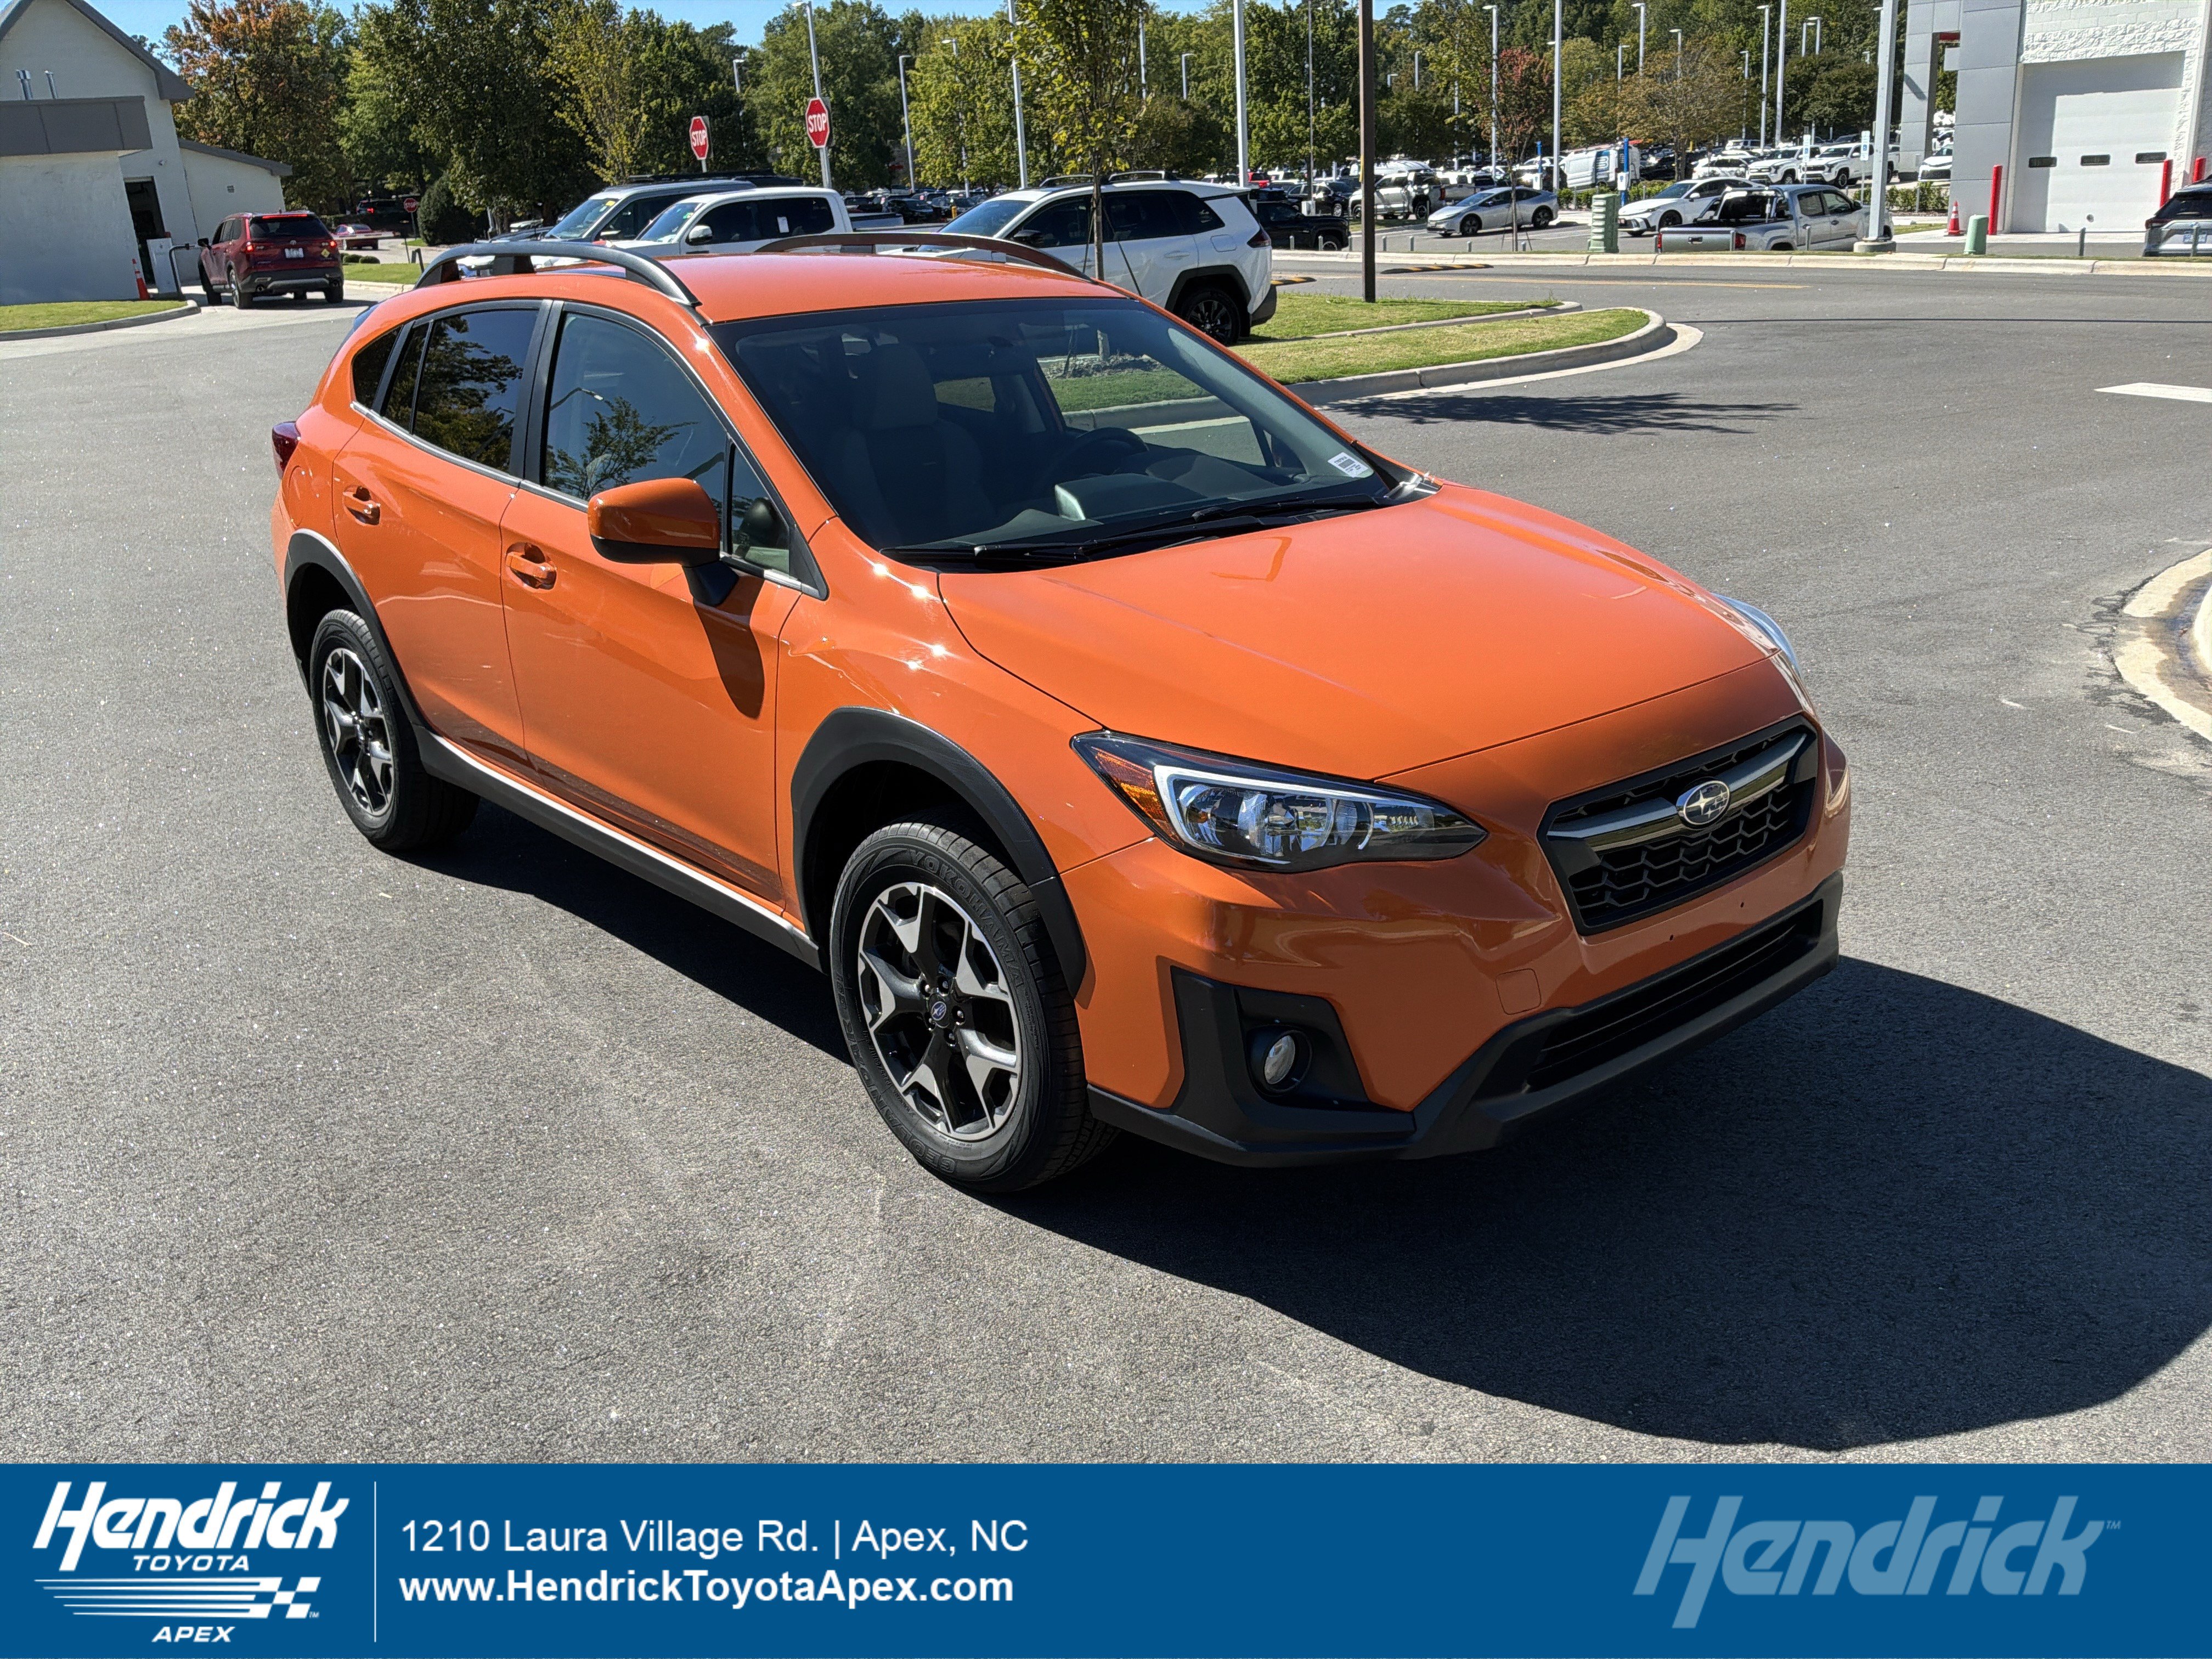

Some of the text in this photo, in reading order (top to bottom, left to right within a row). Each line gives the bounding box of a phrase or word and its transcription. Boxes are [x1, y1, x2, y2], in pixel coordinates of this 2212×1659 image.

[808, 112, 827, 133] STOP
[691, 129, 707, 147] STOP
[910, 849, 1025, 989] YOKOHAMA
